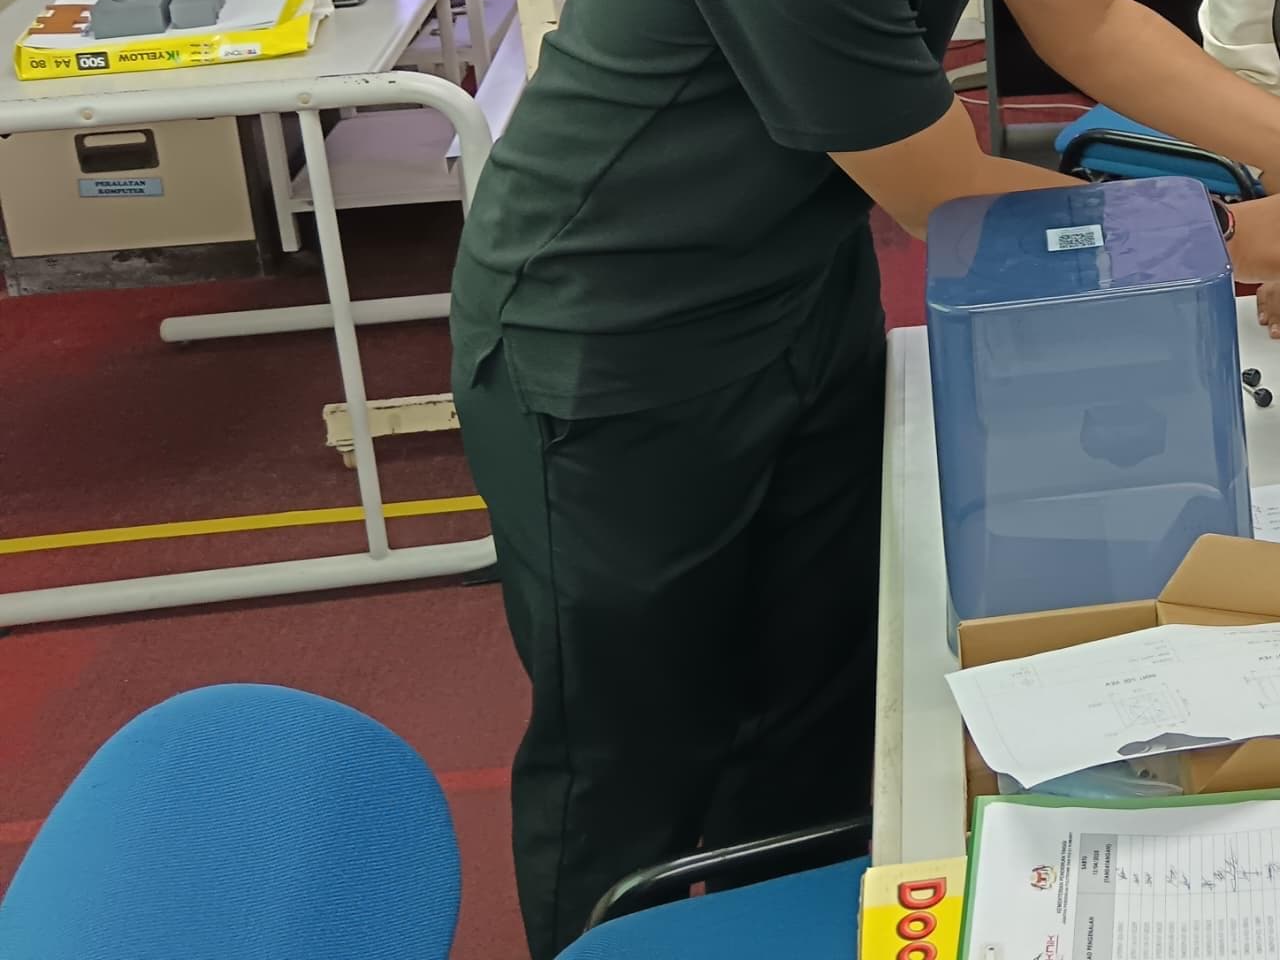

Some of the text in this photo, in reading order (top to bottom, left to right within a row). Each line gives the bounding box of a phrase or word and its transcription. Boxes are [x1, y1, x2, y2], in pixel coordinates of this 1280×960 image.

[79, 56, 106, 68] 500
[118, 51, 166, 63] YELLOW
[30, 60, 47, 69] 80
[53, 58, 71, 69] A4
[95, 180, 146, 188] PERALATAN
